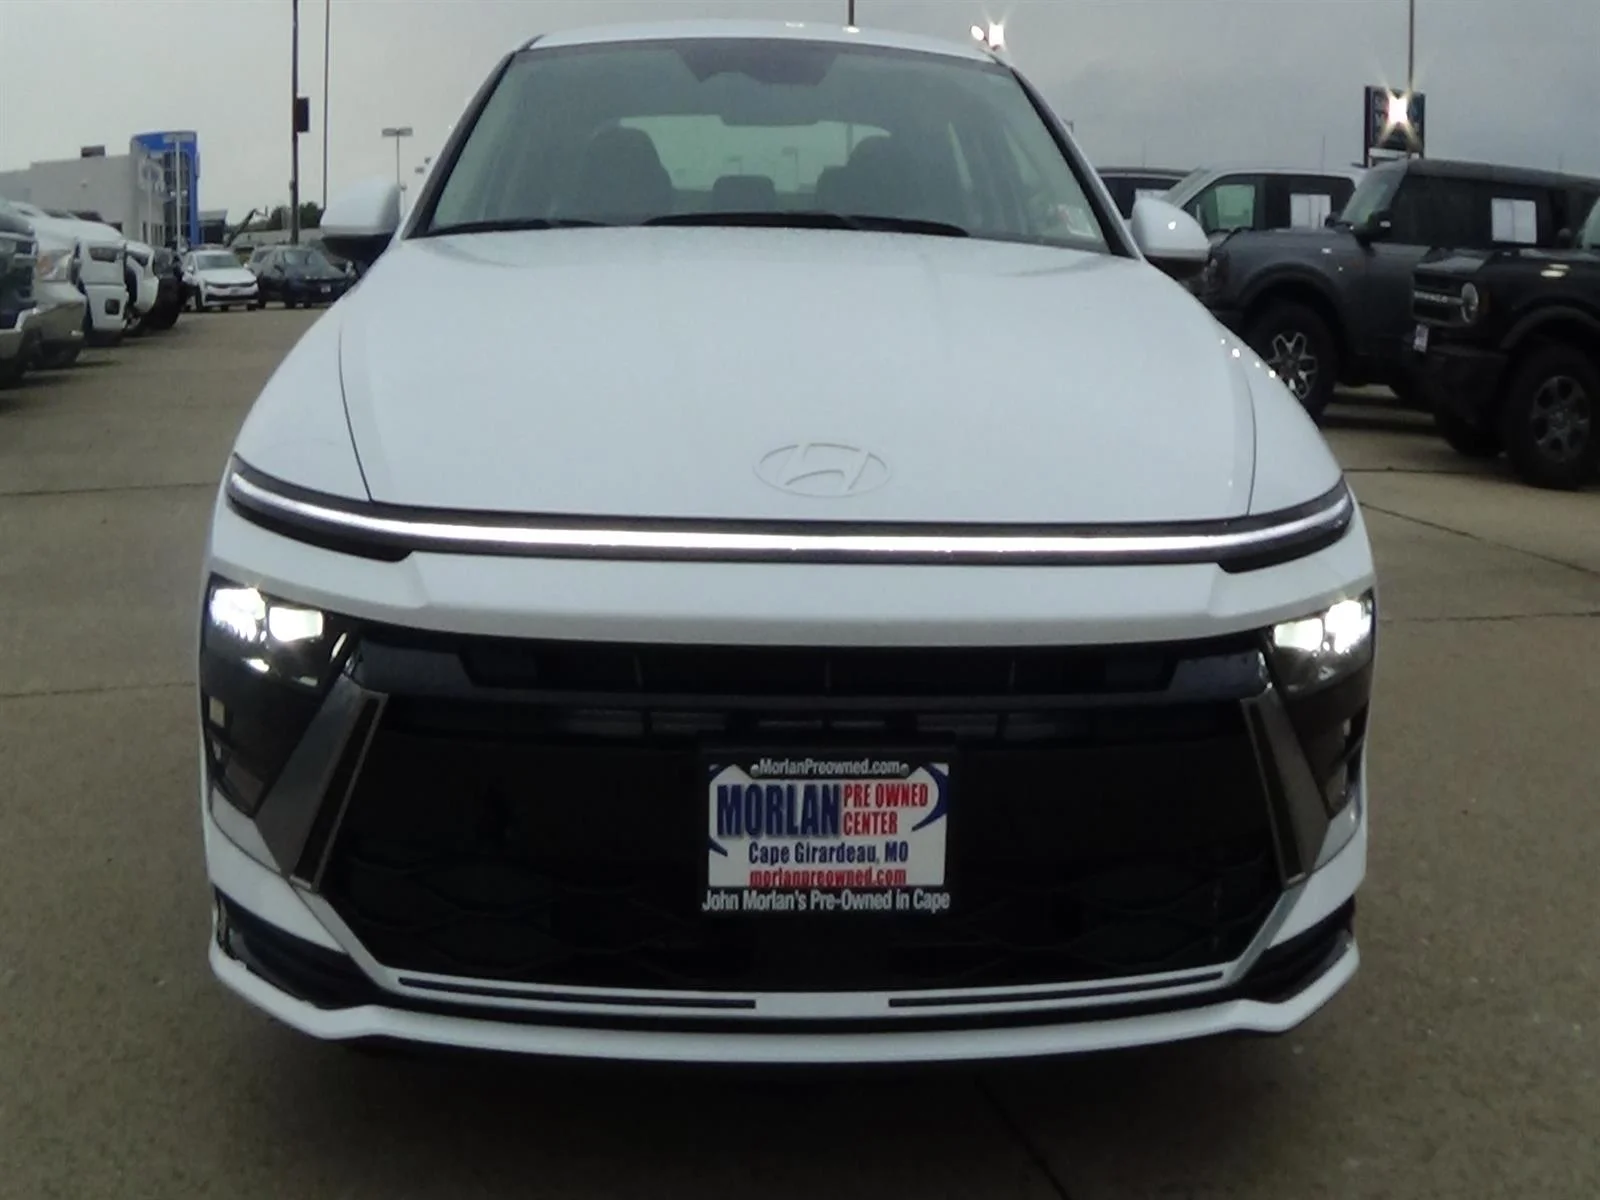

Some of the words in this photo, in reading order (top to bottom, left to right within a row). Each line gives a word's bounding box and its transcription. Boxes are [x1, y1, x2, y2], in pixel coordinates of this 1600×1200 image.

[759, 758, 900, 775] MorlanPreowned.com
[843, 784, 871, 807] PRE
[875, 784, 928, 807] OWNED
[717, 784, 841, 836] MORLAN
[843, 811, 897, 836] CENTER
[749, 842, 790, 866] Cape
[794, 842, 881, 864] Girardeau,
[884, 841, 909, 863] MO
[702, 890, 739, 911] John
[743, 890, 807, 911] Morlan's
[810, 890, 892, 911] Pre-Owned
[896, 888, 910, 910] in
[913, 888, 950, 913] Cape
